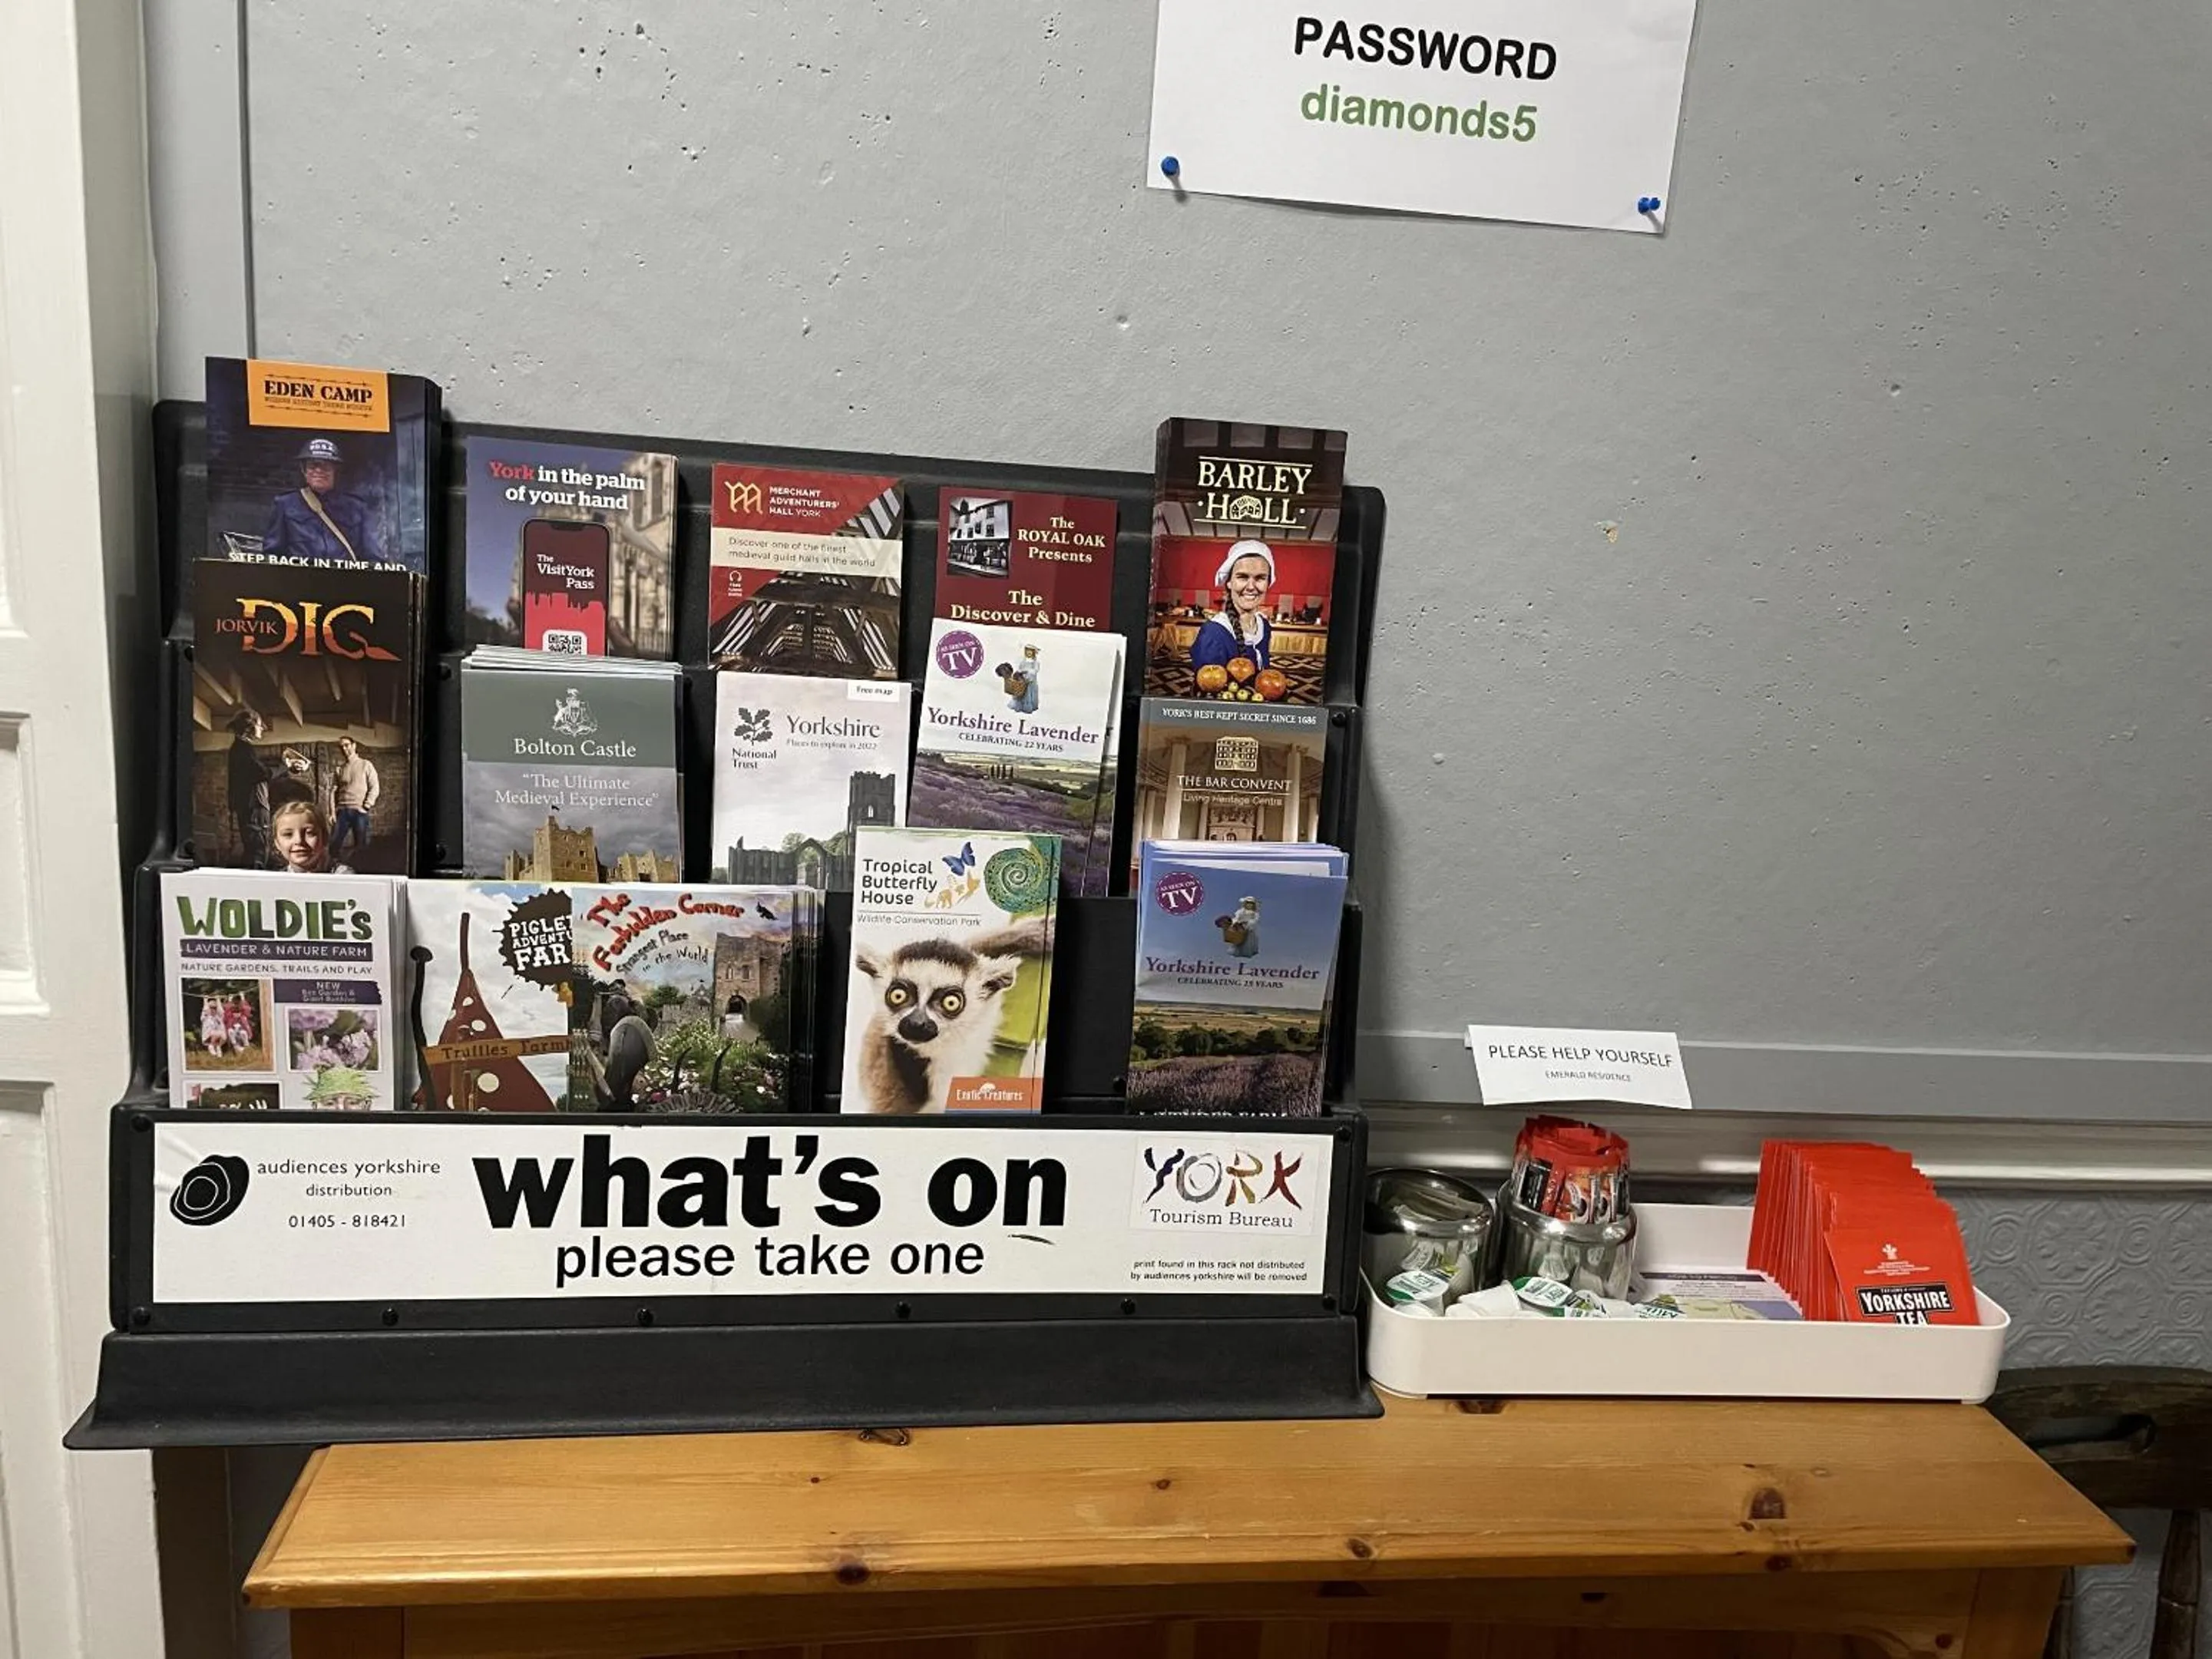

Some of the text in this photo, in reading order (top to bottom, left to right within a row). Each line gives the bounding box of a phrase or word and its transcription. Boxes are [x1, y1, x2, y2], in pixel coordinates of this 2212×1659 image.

[1294, 17, 1557, 81] PASSWORD
[1301, 84, 1538, 142] diamonds5
[265, 380, 372, 402] EDEN CAMP
[489, 461, 645, 491] York in the palm
[1198, 461, 1311, 494] BARLEY
[506, 485, 628, 510] of your hand
[769, 487, 821, 497] MERCHANT
[769, 507, 822, 517] HALL YORK
[1050, 517, 1075, 529] The
[729, 538, 768, 547] Discover
[1018, 530, 1106, 547] ROYAL OAK
[269, 554, 309, 567] BACK
[314, 558, 329, 567] IN
[334, 559, 369, 570] TIME
[729, 550, 770, 560] medieval
[832, 557, 846, 565] the
[1029, 547, 1093, 563] Presents
[567, 578, 594, 589] Pass
[1009, 590, 1043, 605] The
[951, 604, 1095, 627] Discover & Dine
[215, 619, 278, 635] JORVIK
[236, 598, 402, 661] DIG
[942, 647, 977, 669] TV
[928, 706, 1099, 743] Yorkshire Lavender
[1194, 710, 1215, 719] BEST
[1216, 712, 1238, 720] KEPT
[1239, 713, 1270, 722] SECRET
[1271, 715, 1296, 723] SINCE
[787, 715, 880, 738] Yorkshire
[514, 739, 636, 758] Bolton Castle
[959, 732, 1022, 748] CELEBRATING
[1037, 742, 1063, 752] YEARS
[732, 749, 776, 759] National
[732, 759, 758, 769] Trust
[565, 775, 630, 789] Ultimate
[1177, 775, 1292, 791] THE BAR CONVENT
[495, 790, 564, 806] Medieval
[1184, 794, 1209, 804] Living
[863, 859, 932, 874] Tropical
[863, 875, 937, 892] Butterfly
[861, 891, 914, 904] House
[1162, 886, 1197, 908] TV
[587, 893, 631, 927] The
[593, 893, 745, 971] Forbidden Corner
[186, 944, 367, 957] LAVENDER & NATURE FARM
[514, 944, 570, 970] FAR
[617, 930, 689, 974] Strangest Place
[655, 953, 671, 964] the
[676, 946, 708, 963] World
[283, 965, 319, 973] TRAILS
[322, 966, 344, 974] AND
[1146, 957, 1319, 980] Yorkshire Lavender
[1178, 977, 1241, 986] CELEBRATING
[1489, 1046, 1672, 1067] PLEASE HELP YOURSELF
[1546, 1070, 1585, 1079] EMERALD
[257, 1159, 441, 1177] audiences yorkshire
[471, 1135, 1066, 1228] what's on
[1142, 1147, 1304, 1210] YORK
[306, 1184, 392, 1196] distribution
[289, 1215, 335, 1228] 01405
[352, 1215, 405, 1227] 818421
[1150, 1209, 1292, 1227] Tourism Bureau
[557, 1235, 984, 1288] please take one
[1134, 1261, 1155, 1269] print
[1194, 1274, 1235, 1282] yorkshire
[1861, 1291, 1949, 1313] YORKSHIRE
[1896, 1311, 1927, 1324] TEA
